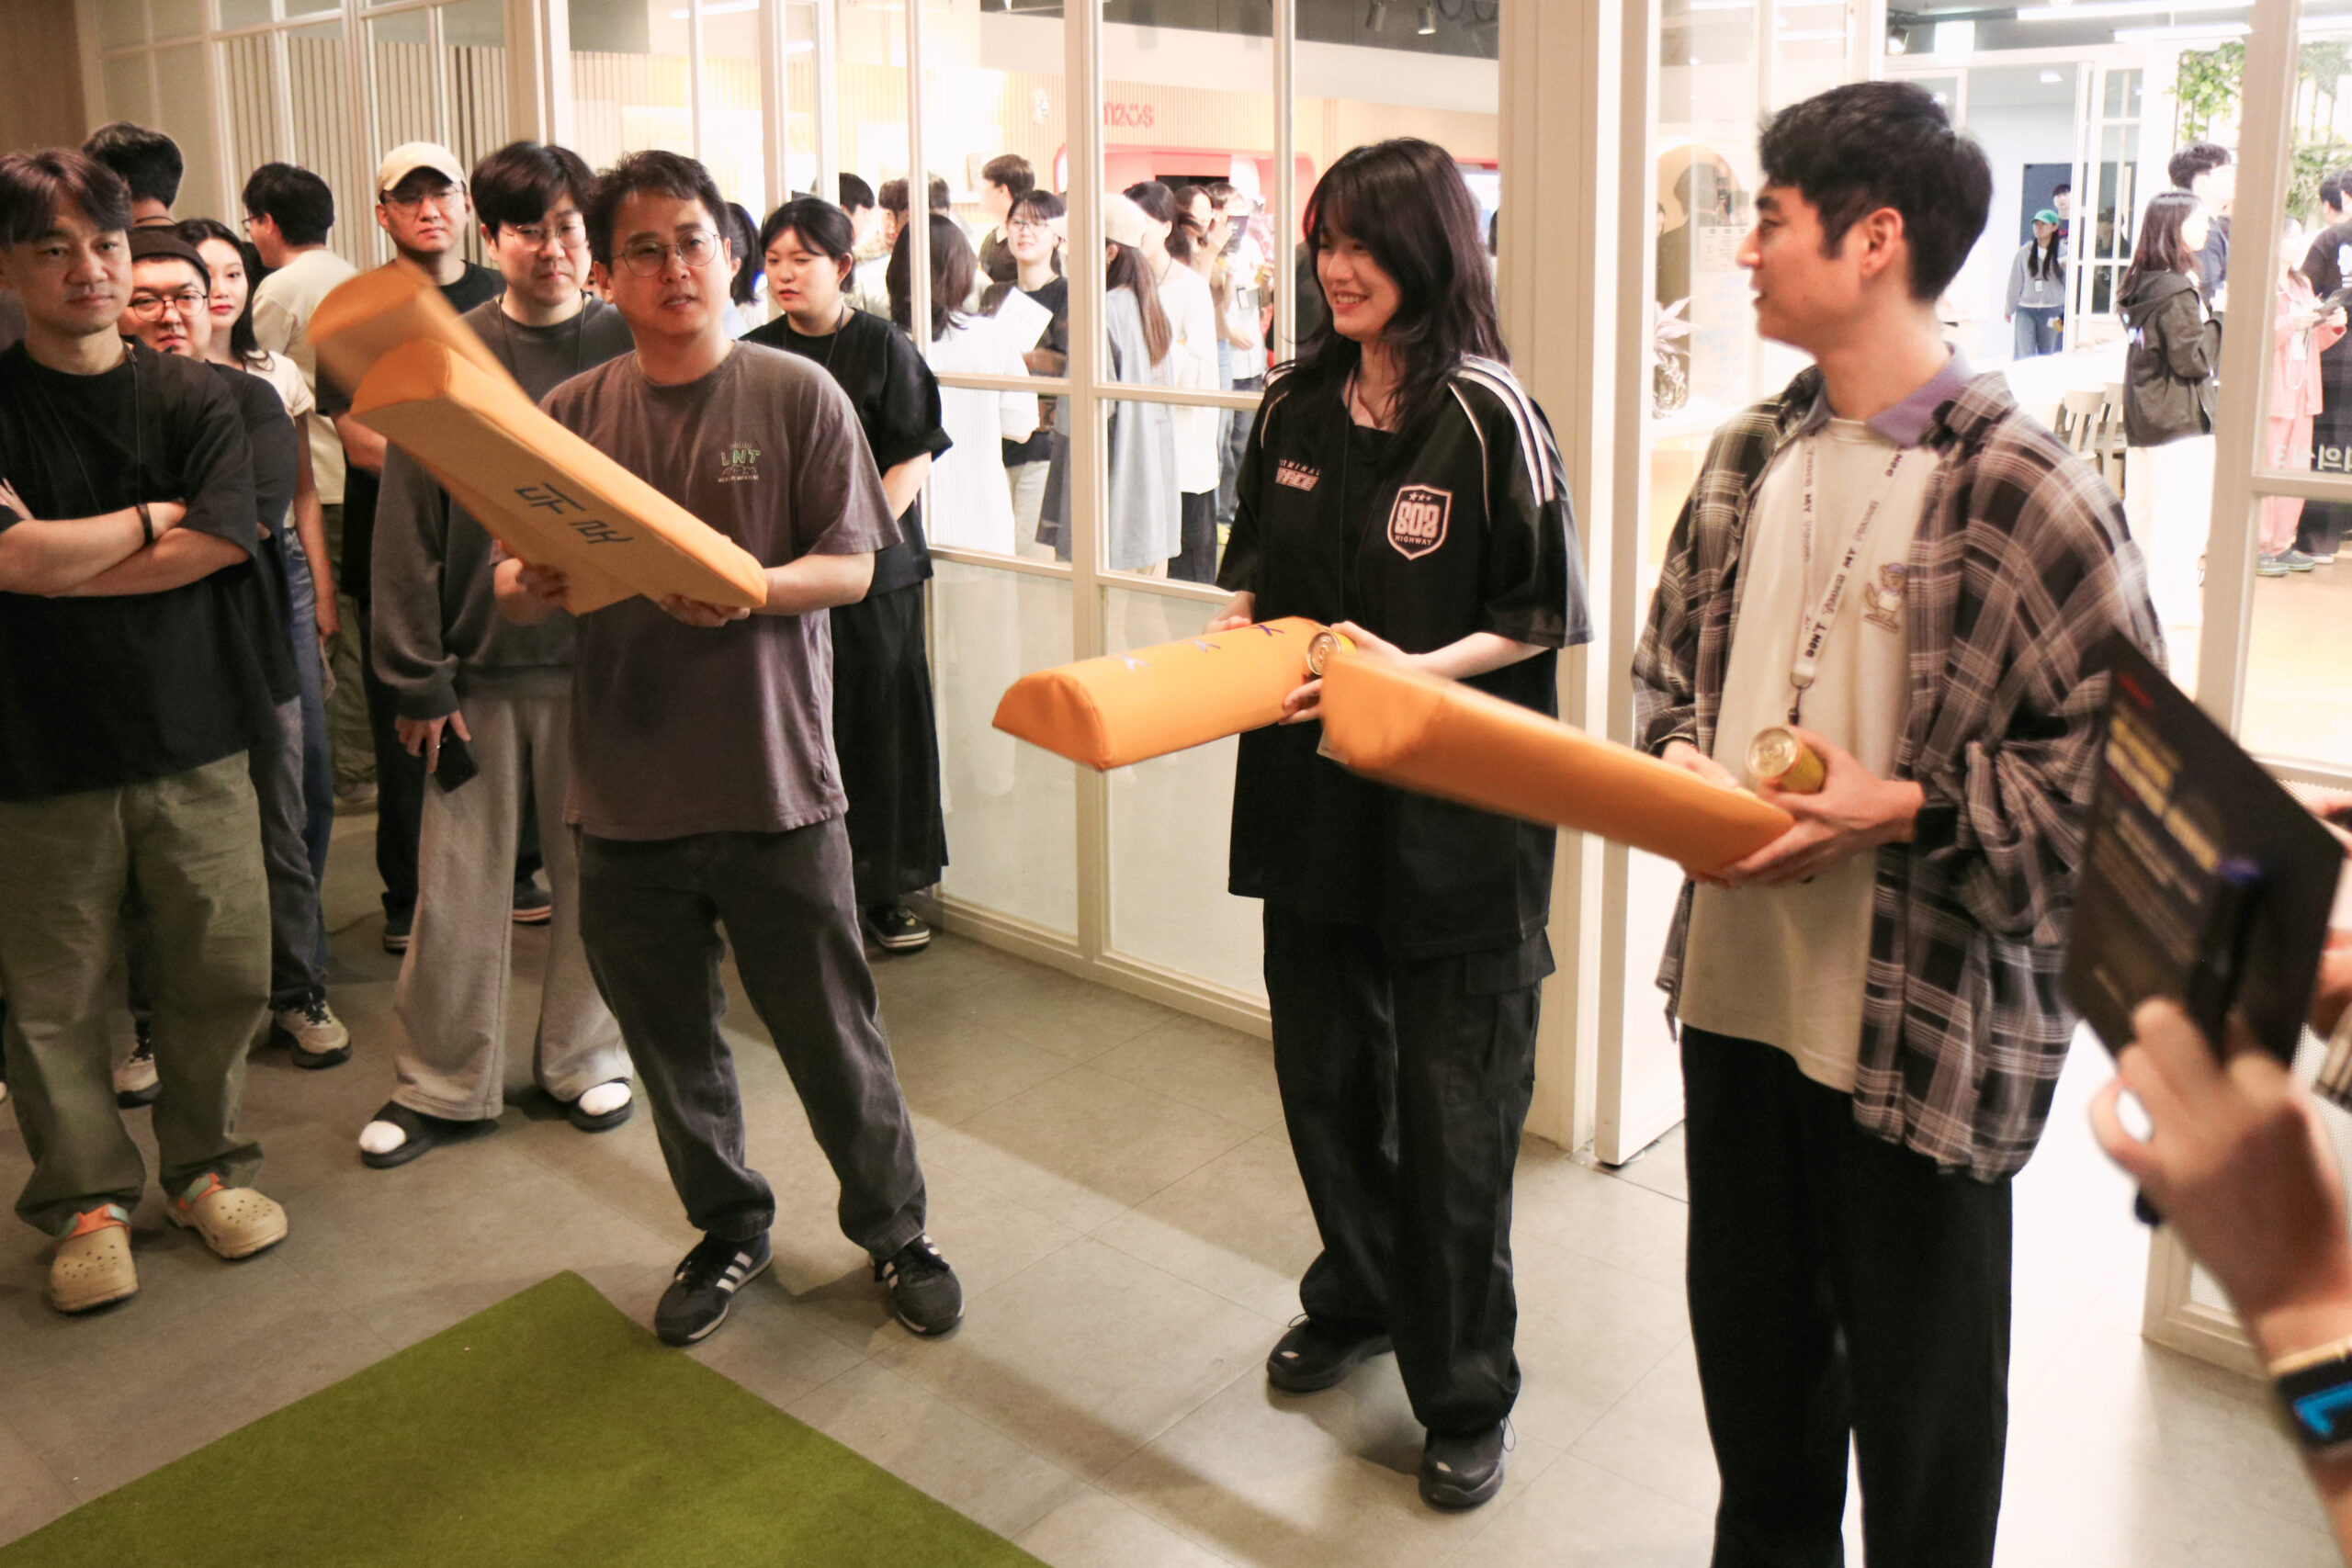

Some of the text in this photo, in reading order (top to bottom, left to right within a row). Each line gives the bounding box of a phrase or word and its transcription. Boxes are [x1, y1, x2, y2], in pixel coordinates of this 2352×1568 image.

[720, 448, 762, 467] LNT
[1395, 501, 1441, 539] 808
[1395, 535, 1433, 547] HIGHWAY
[1804, 622, 1827, 659] DON'T
[1842, 547, 1857, 569] MY
